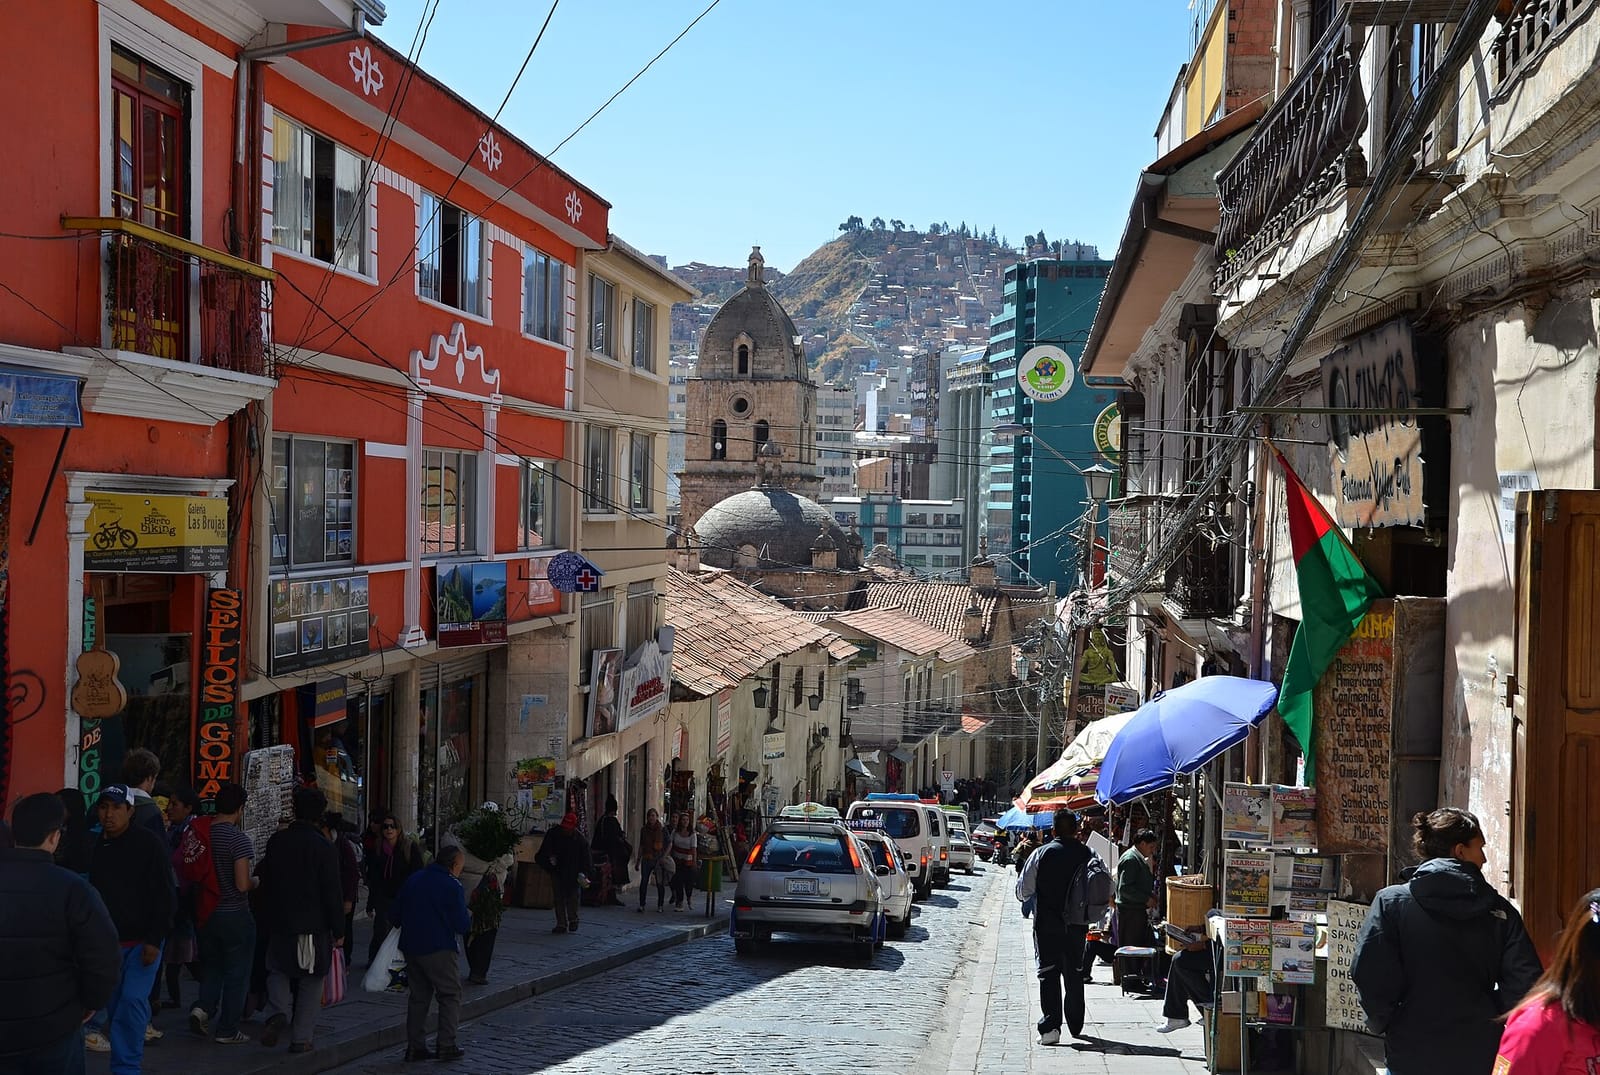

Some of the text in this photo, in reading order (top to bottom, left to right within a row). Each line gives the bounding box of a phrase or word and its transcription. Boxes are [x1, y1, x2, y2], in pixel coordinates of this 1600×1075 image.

[1097, 413, 1115, 449] HOTEL
[188, 514, 226, 533] Las Brujas
[204, 589, 240, 703] SELLOS
[1336, 658, 1384, 676] Desayunos
[204, 704, 233, 722] DE
[1227, 920, 1248, 930] Buena
[1242, 947, 1270, 955] VISTA
